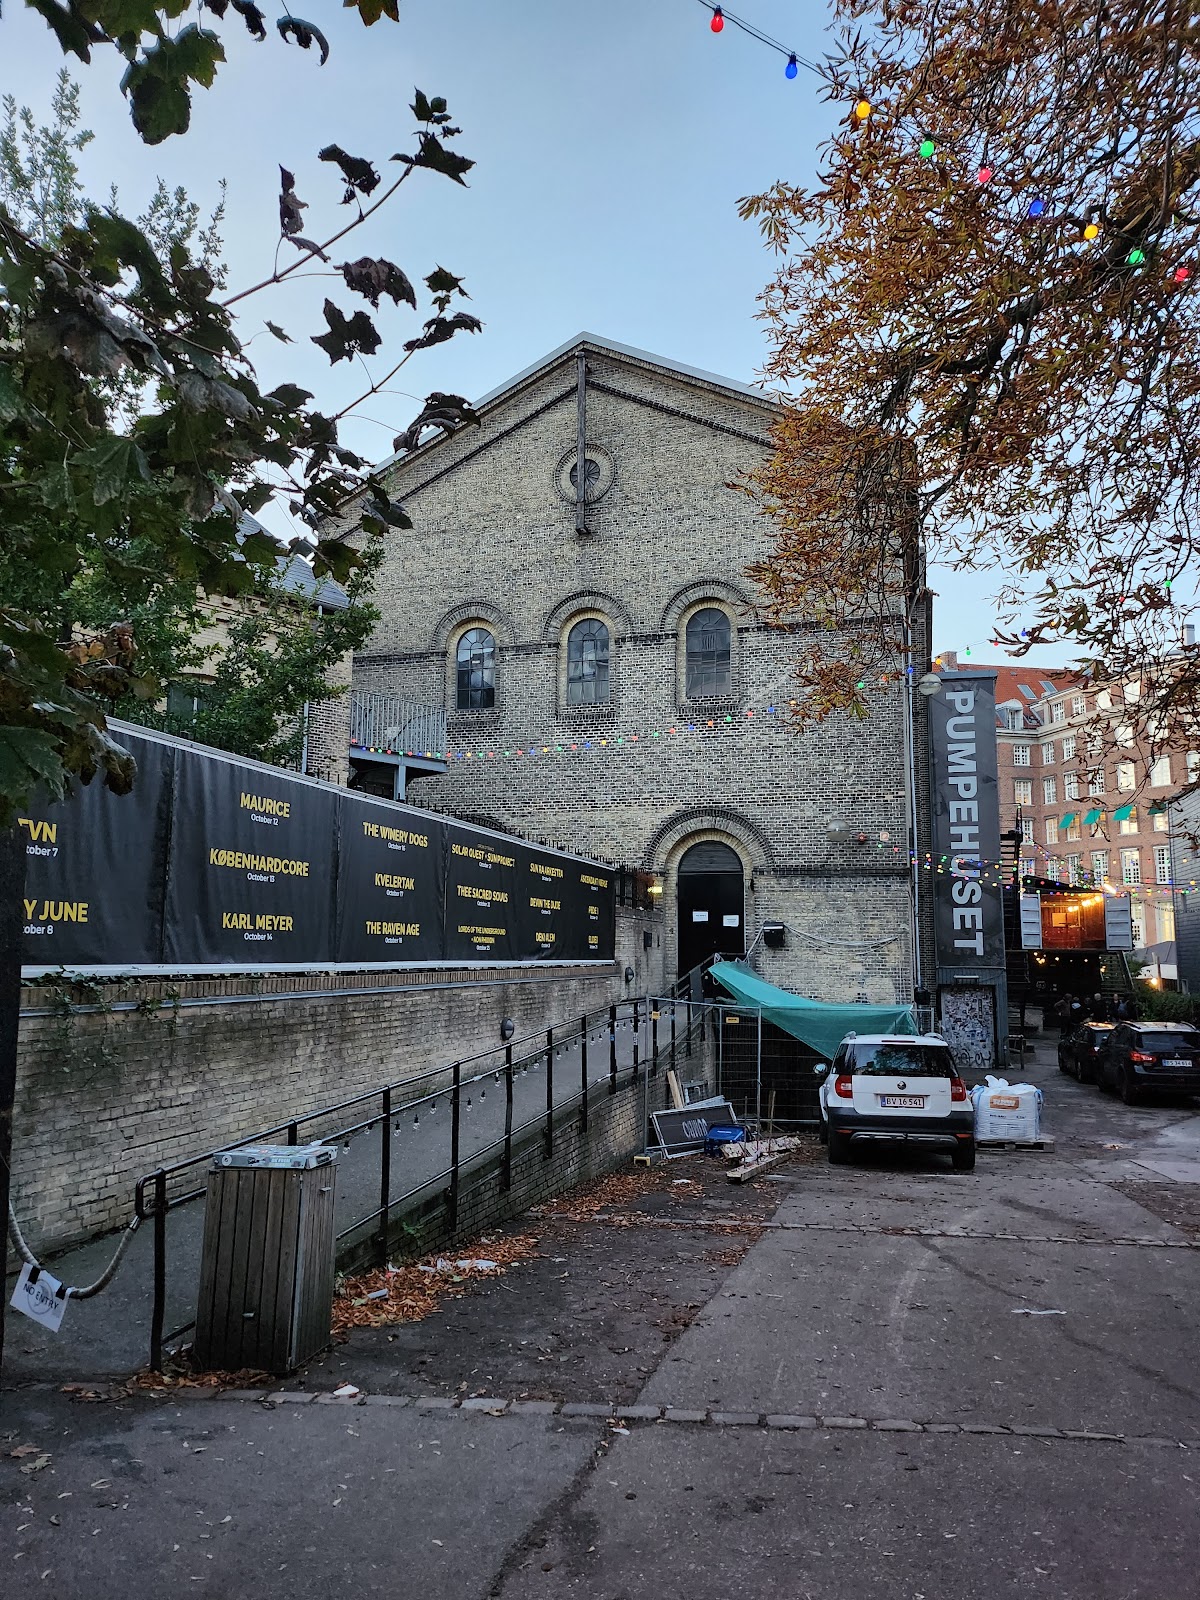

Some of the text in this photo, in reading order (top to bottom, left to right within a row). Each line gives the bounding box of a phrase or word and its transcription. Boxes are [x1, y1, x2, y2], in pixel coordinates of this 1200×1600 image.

[240, 792, 290, 818] MAURICE
[250, 814, 278, 826] October 12
[945, 690, 984, 956] PUMPEHUSET
[18, 818, 57, 843] VN
[362, 822, 428, 848] THE WINERY DOGS
[26, 844, 58, 856] tober 7
[452, 844, 468, 856] SOLAR
[210, 848, 310, 876] KØBENHARDCORE
[247, 873, 275, 883] October 13
[375, 872, 415, 890] KVELERTAK
[457, 885, 472, 898] THEE
[472, 888, 492, 900] SACRED
[39, 900, 89, 922] JUNE
[23, 924, 54, 935] ober 8
[222, 912, 293, 931] KARL MEYER
[366, 921, 420, 936] THE RAVEN AGE
[23, 1283, 59, 1310] NO ENTRY
